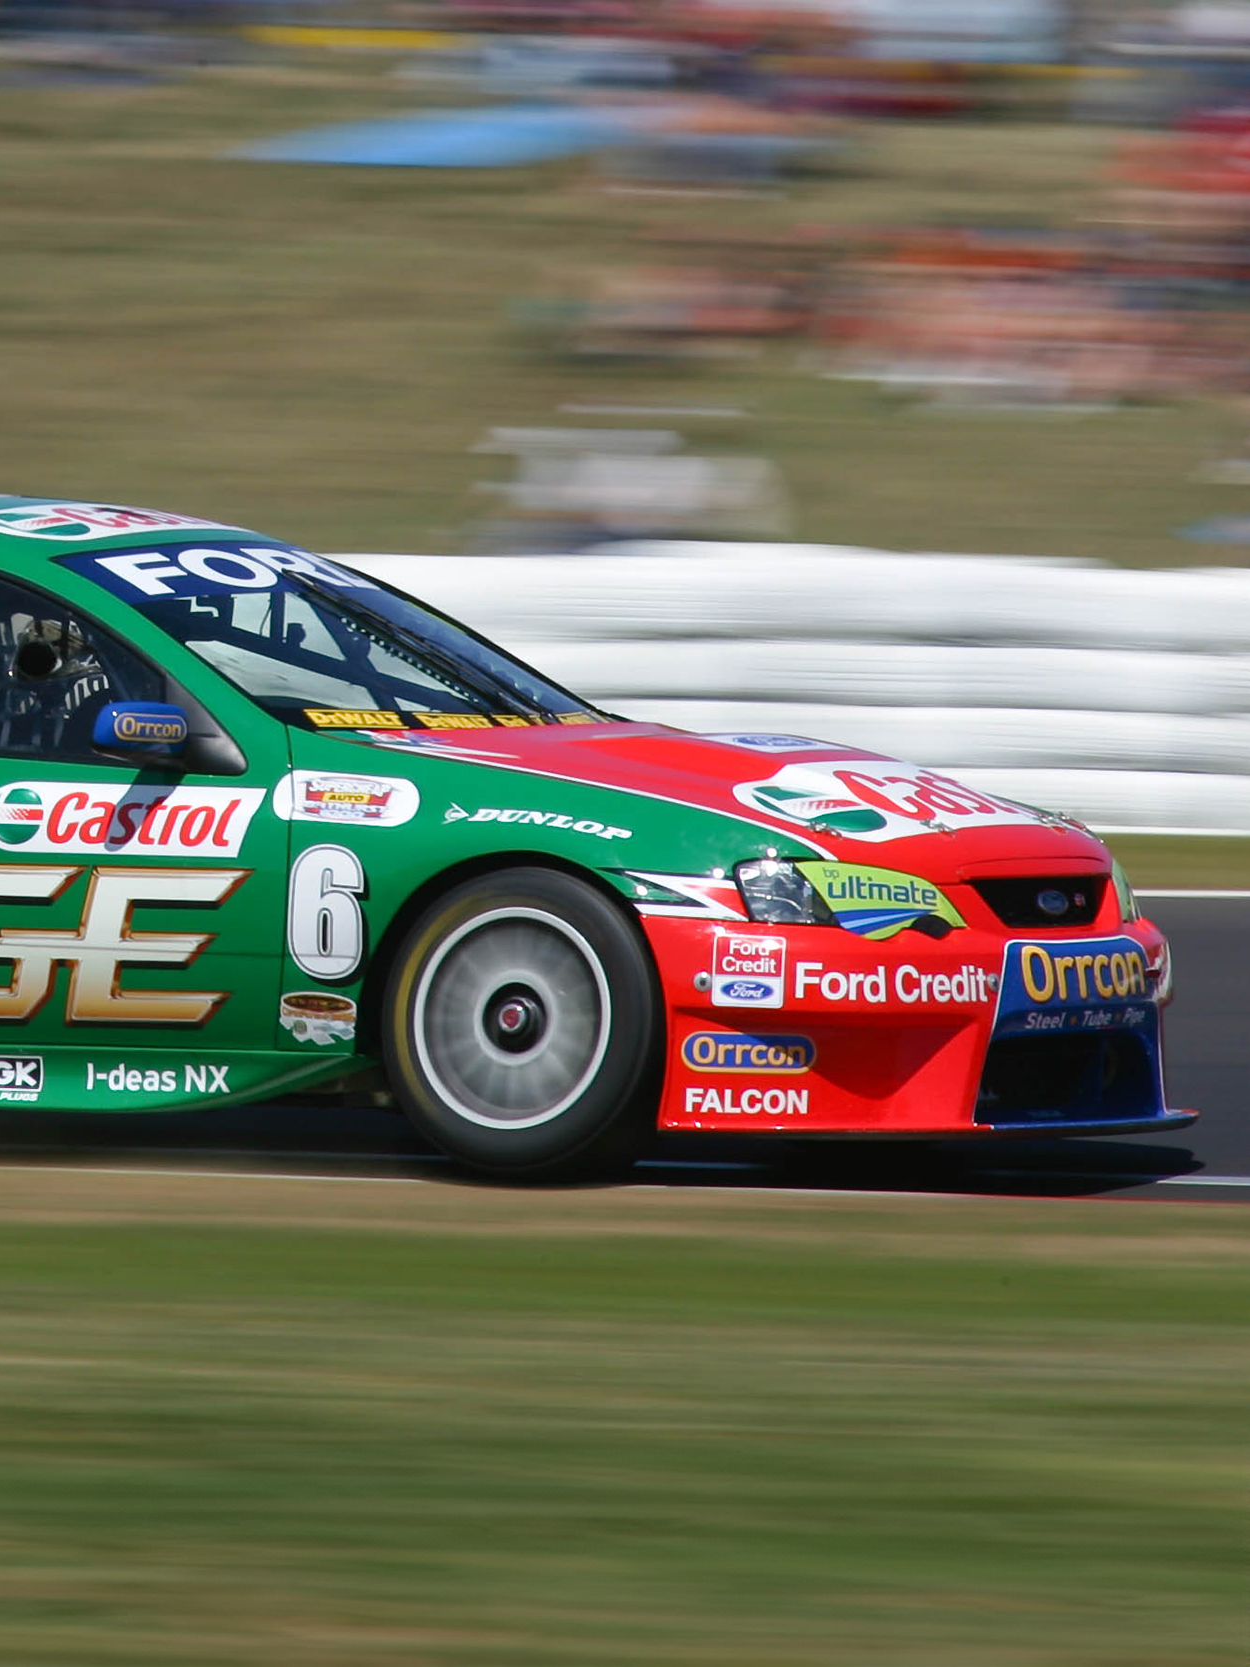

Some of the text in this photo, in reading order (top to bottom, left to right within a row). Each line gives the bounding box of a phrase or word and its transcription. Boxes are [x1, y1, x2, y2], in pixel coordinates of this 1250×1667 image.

[121, 716, 182, 737] Orrcon
[329, 794, 364, 802] AUTO
[833, 769, 1022, 821] Cast
[46, 792, 241, 847] Castrol
[467, 808, 633, 839] DUNLOP
[822, 867, 840, 880] bp
[827, 875, 937, 906] ultimate
[288, 844, 364, 979] 6
[729, 939, 770, 956] Ford
[721, 956, 777, 974] Credit
[1021, 945, 1146, 1002] Orrcon
[730, 983, 764, 998] Ford
[794, 962, 989, 1003] Ford Credit
[1024, 1007, 1146, 1029] Steel Tube Pipe
[692, 1036, 807, 1066] Orrcon
[86, 1062, 231, 1093] I-deas NX
[0, 1092, 39, 1102] PLUGS
[685, 1088, 808, 1114] FALCON
